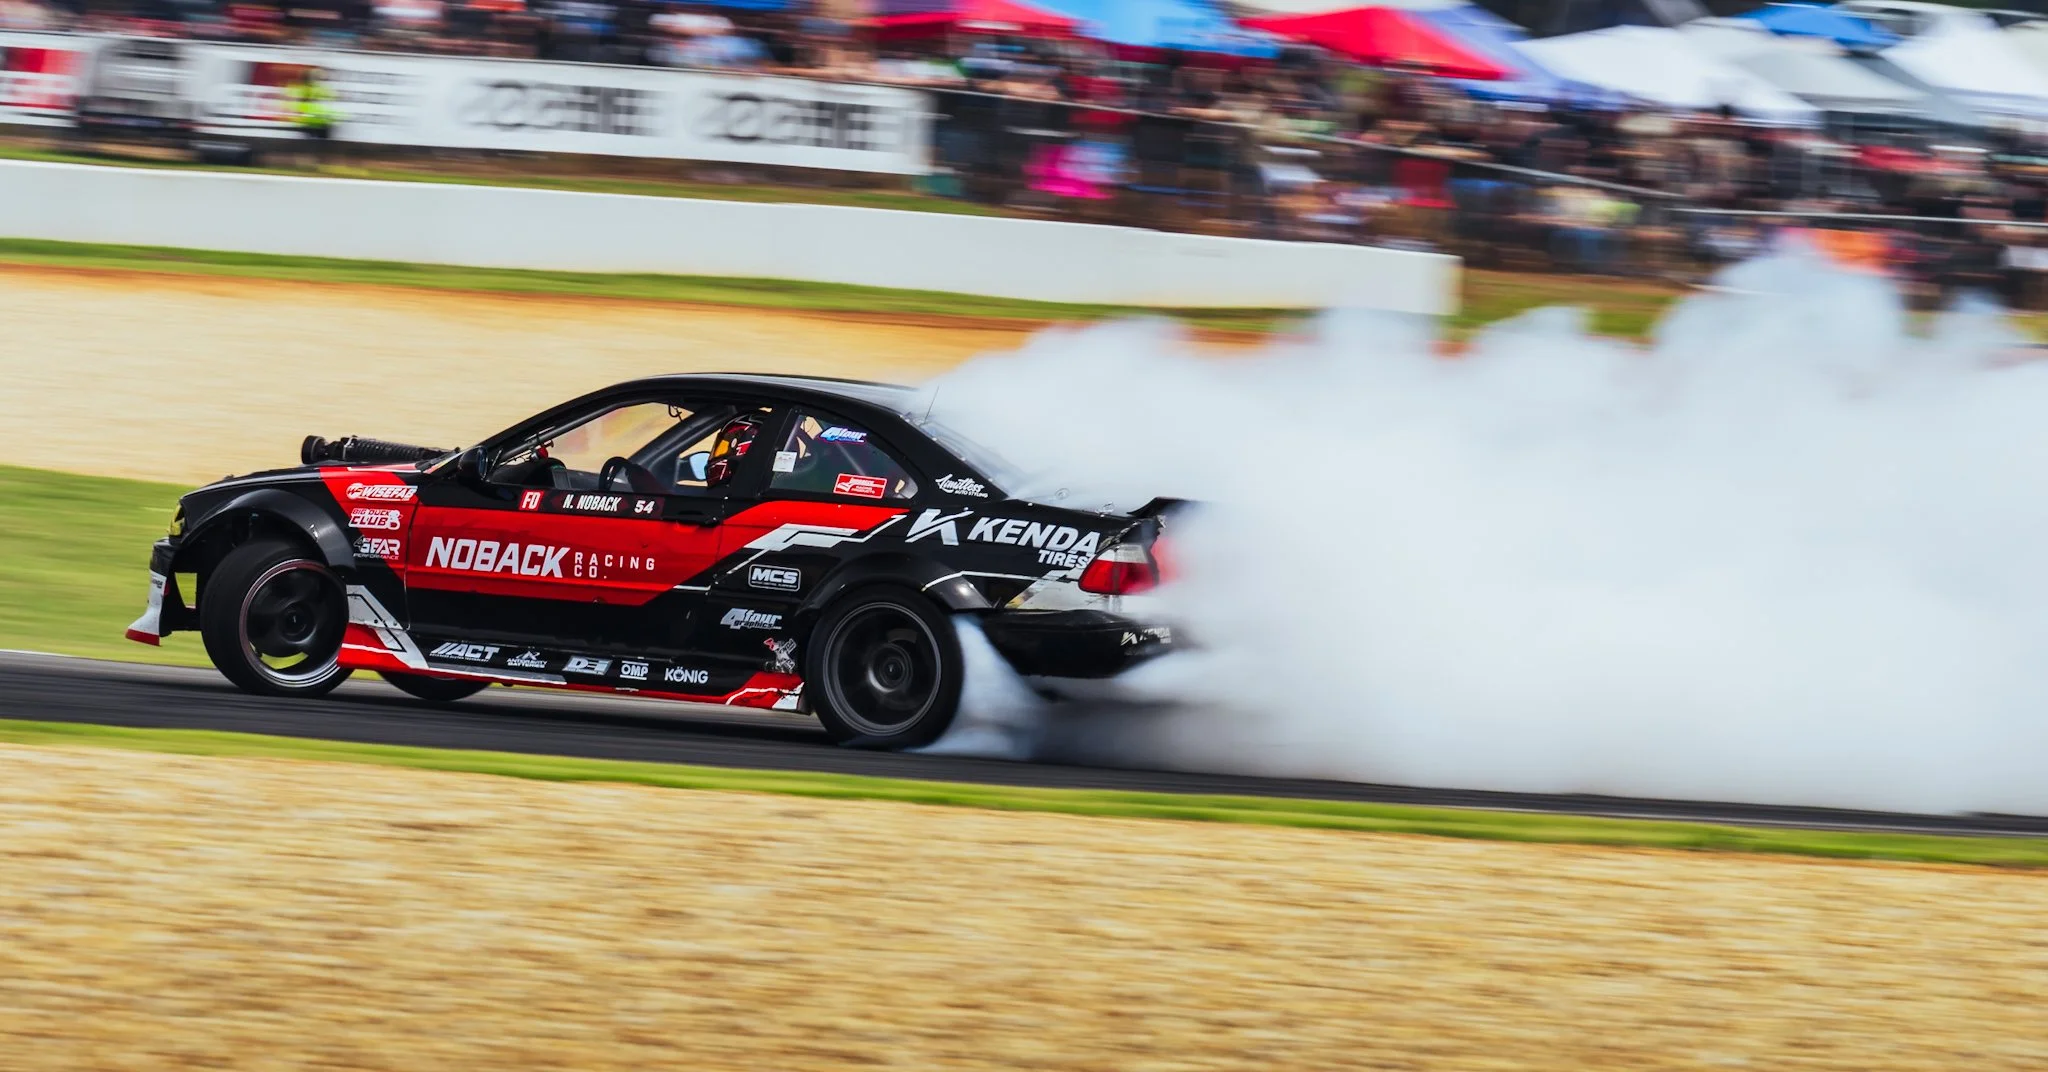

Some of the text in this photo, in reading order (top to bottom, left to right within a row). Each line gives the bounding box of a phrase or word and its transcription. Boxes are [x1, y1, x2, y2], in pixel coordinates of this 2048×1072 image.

[935, 473, 985, 493] Limitless
[361, 485, 418, 500] WISEFAB
[521, 491, 540, 509] FD
[563, 493, 622, 512] N. NOBACK
[634, 500, 655, 514] 54
[350, 515, 389, 527] CLUB
[967, 516, 1101, 555] KENDA
[360, 537, 401, 556] GEAR
[425, 536, 571, 578] NOBACK
[574, 551, 656, 571] RACING
[1038, 549, 1091, 569] TIRES
[574, 564, 608, 579] CO.
[751, 567, 799, 585] MCS
[733, 620, 774, 629] graphics
[620, 663, 649, 677] OMP
[664, 666, 709, 684] KÖNIG
